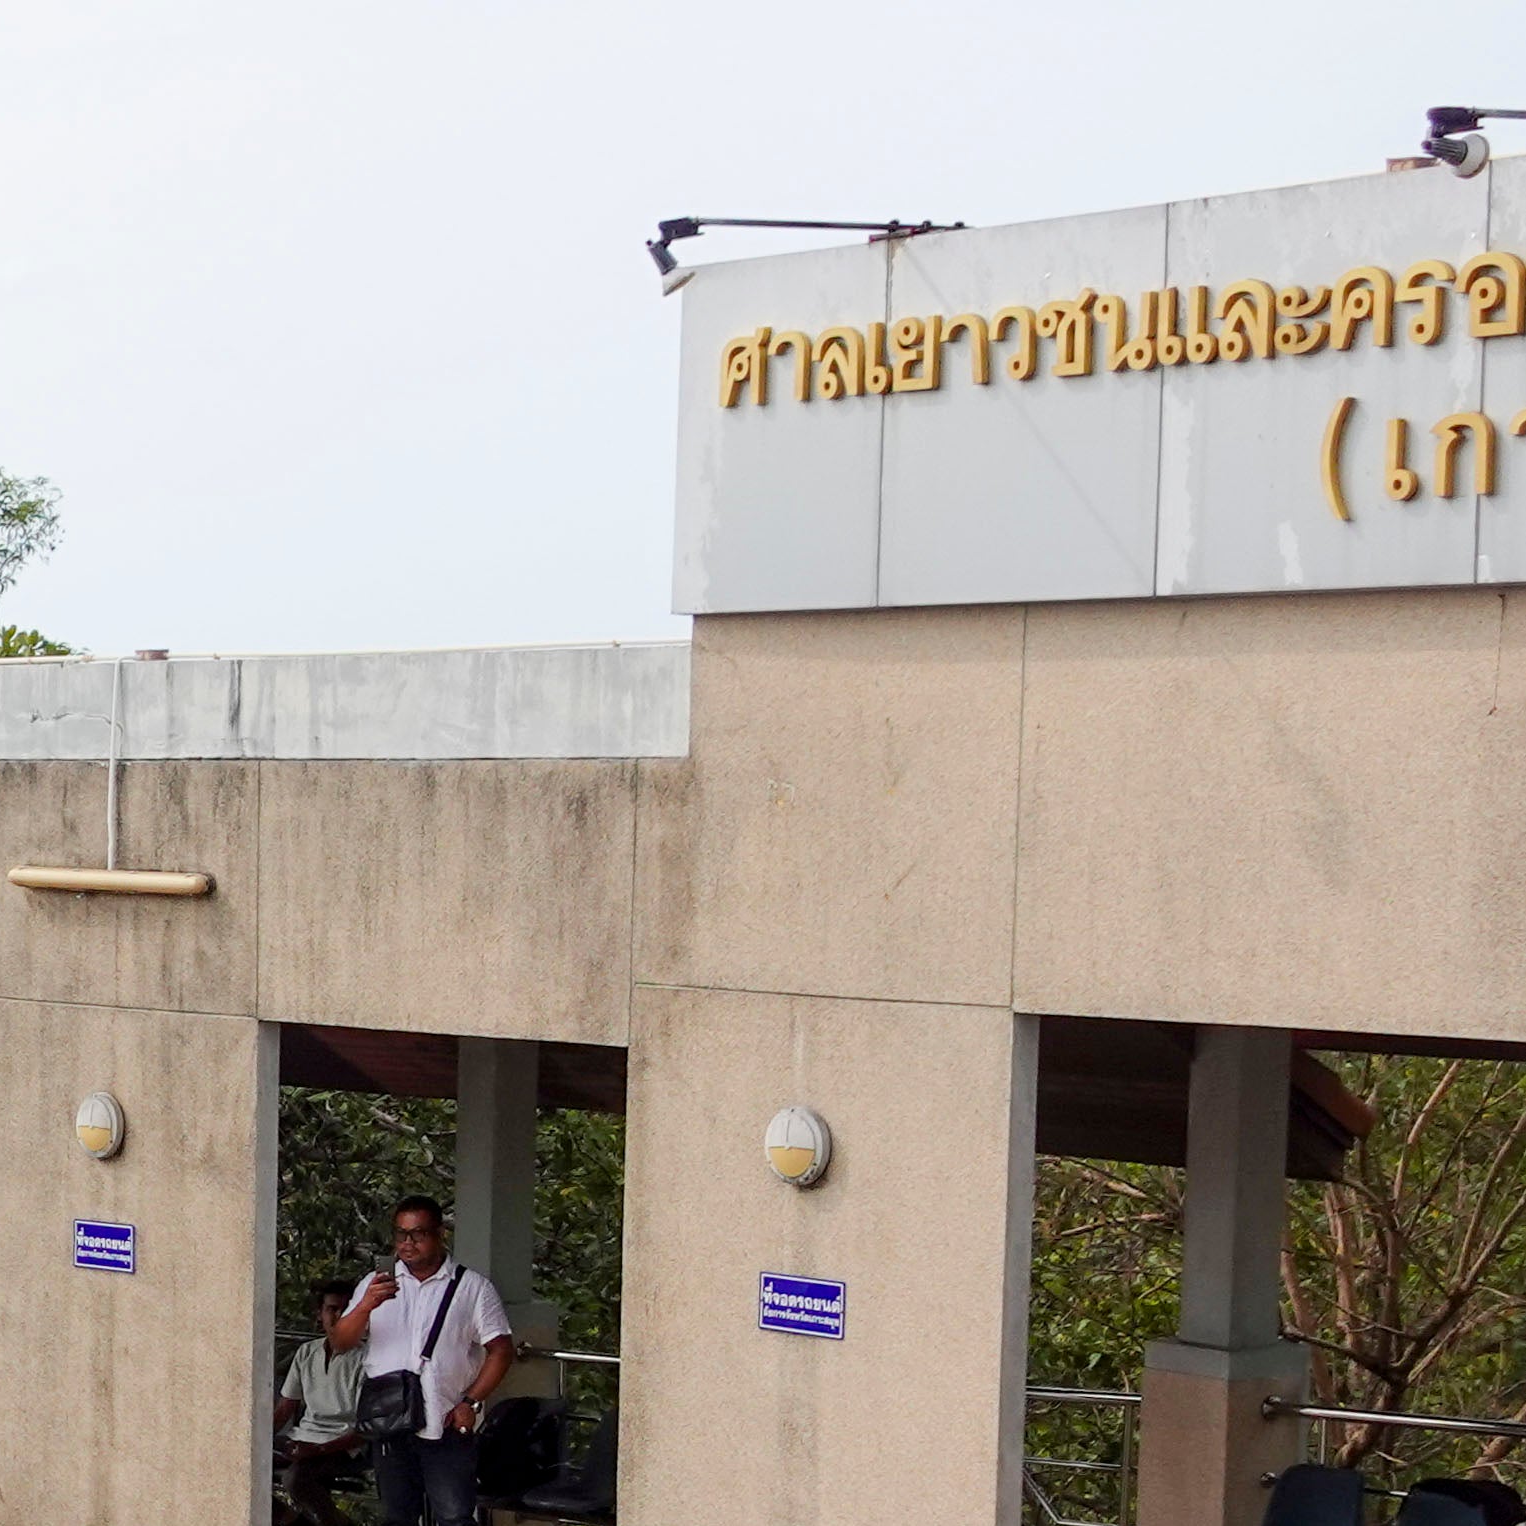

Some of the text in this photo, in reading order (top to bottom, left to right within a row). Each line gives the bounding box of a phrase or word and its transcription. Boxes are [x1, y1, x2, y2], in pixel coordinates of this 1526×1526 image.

[762, 1280, 842, 1315] ที่จอดรถยนต์
